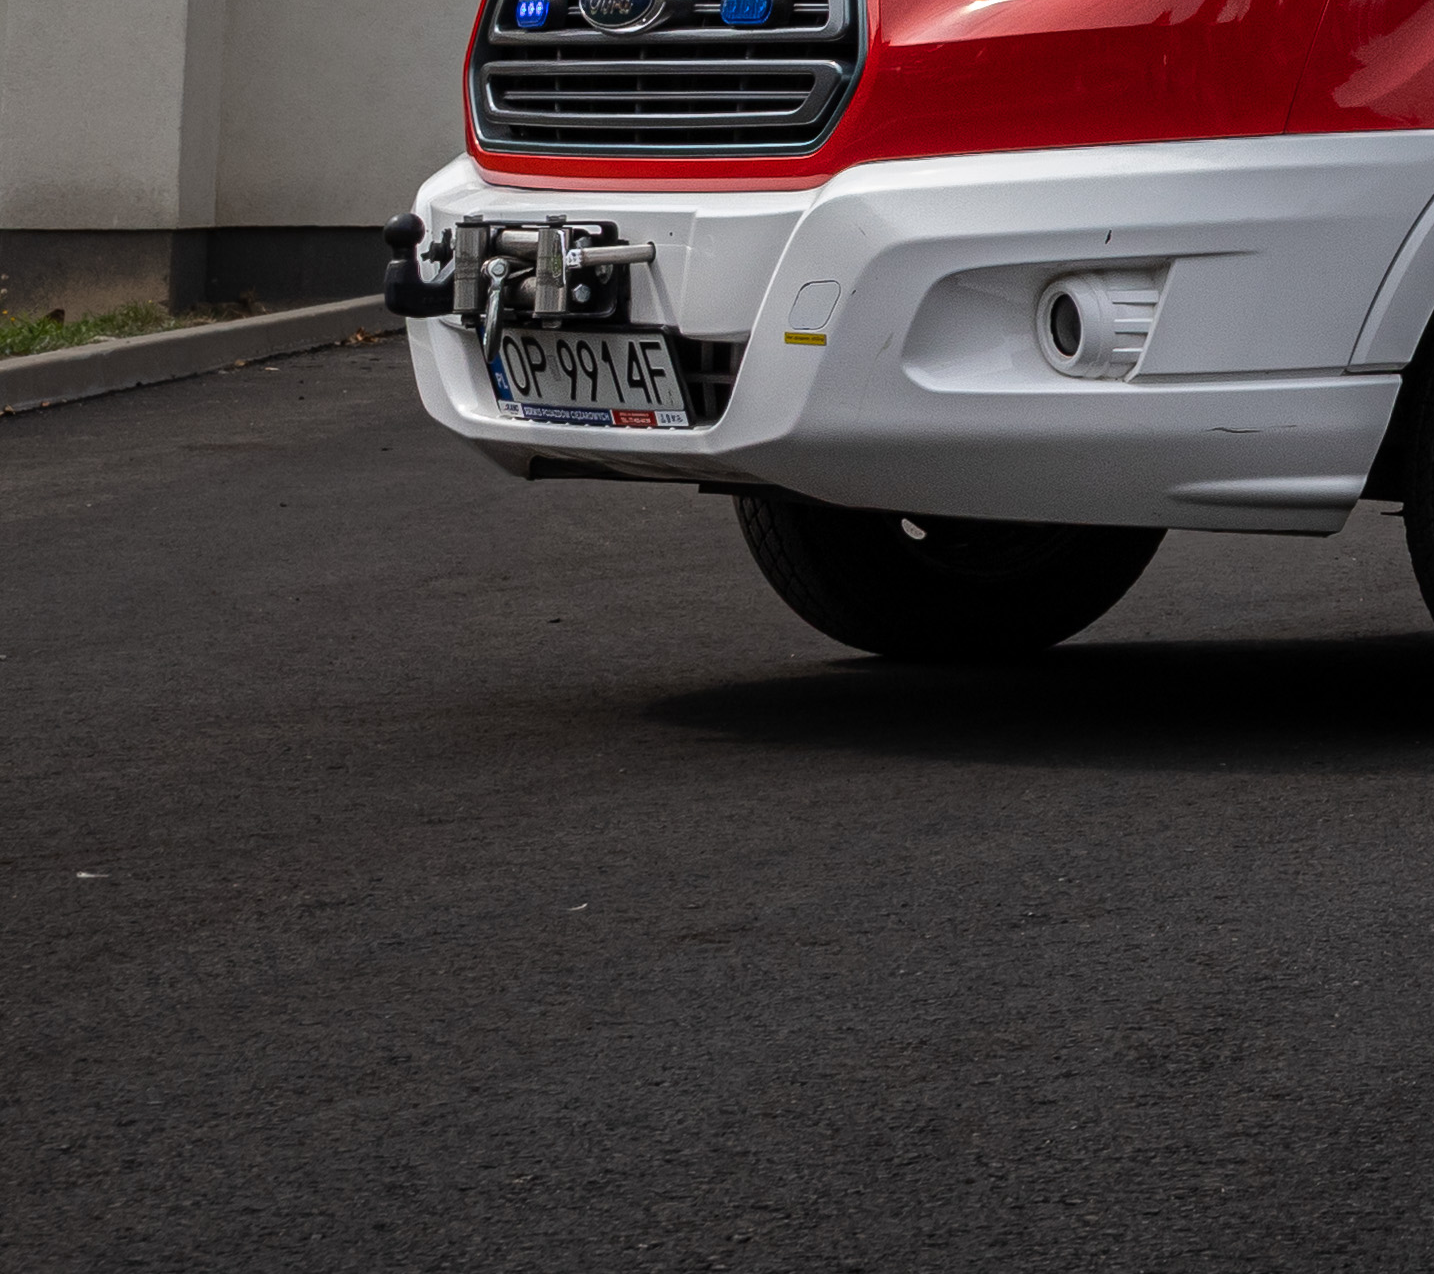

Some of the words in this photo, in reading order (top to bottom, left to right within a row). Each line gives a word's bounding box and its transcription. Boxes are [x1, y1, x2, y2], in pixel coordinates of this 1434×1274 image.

[494, 372, 509, 390] PL
[502, 335, 547, 398] OP
[556, 339, 667, 405] 9914F
